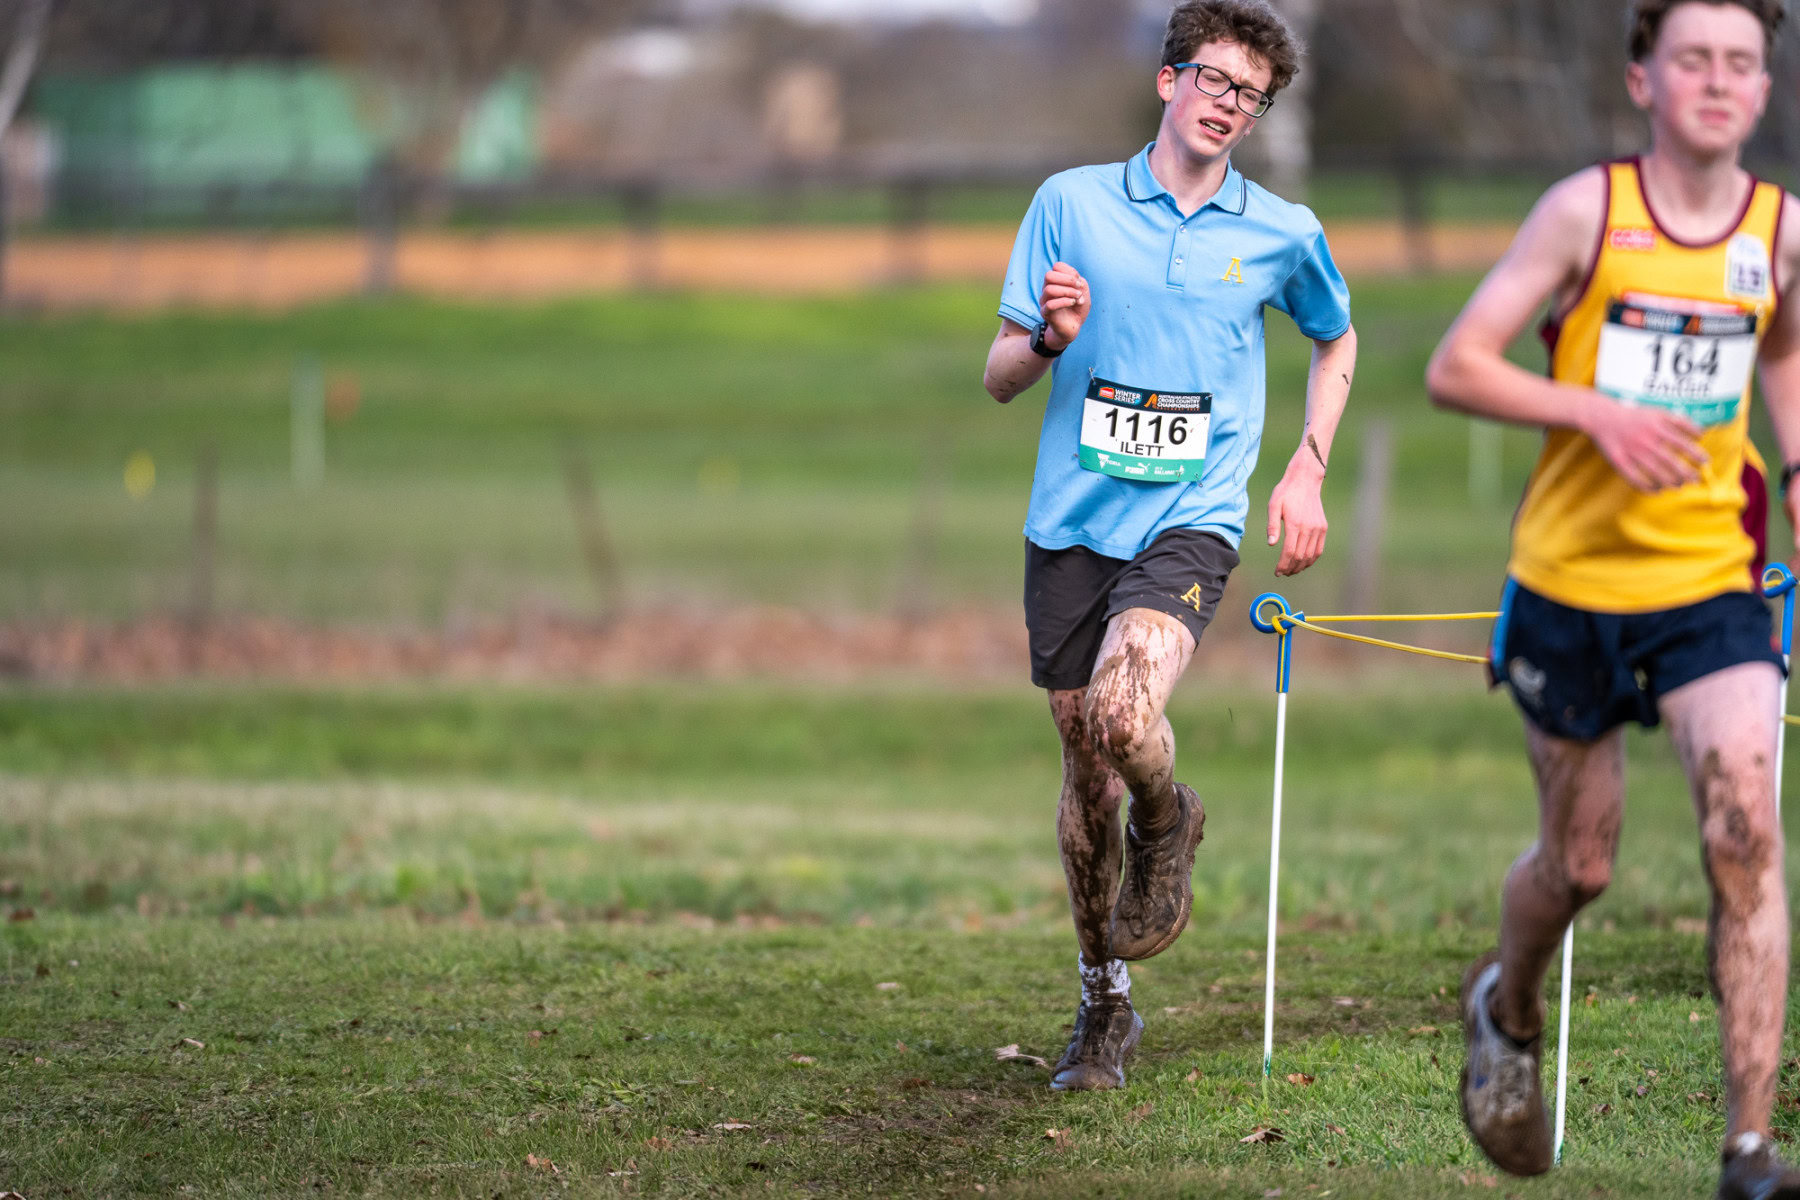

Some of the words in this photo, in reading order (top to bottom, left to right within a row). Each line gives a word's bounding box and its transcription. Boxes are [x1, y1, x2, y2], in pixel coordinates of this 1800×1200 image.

[1221, 257, 1244, 284] A
[1646, 333, 1720, 376] 164
[1114, 394, 1135, 404] SERIES
[1115, 388, 1141, 399] WINTER
[1105, 407, 1188, 445] 1116
[1120, 441, 1165, 457] ILETT
[1180, 582, 1202, 612] A
